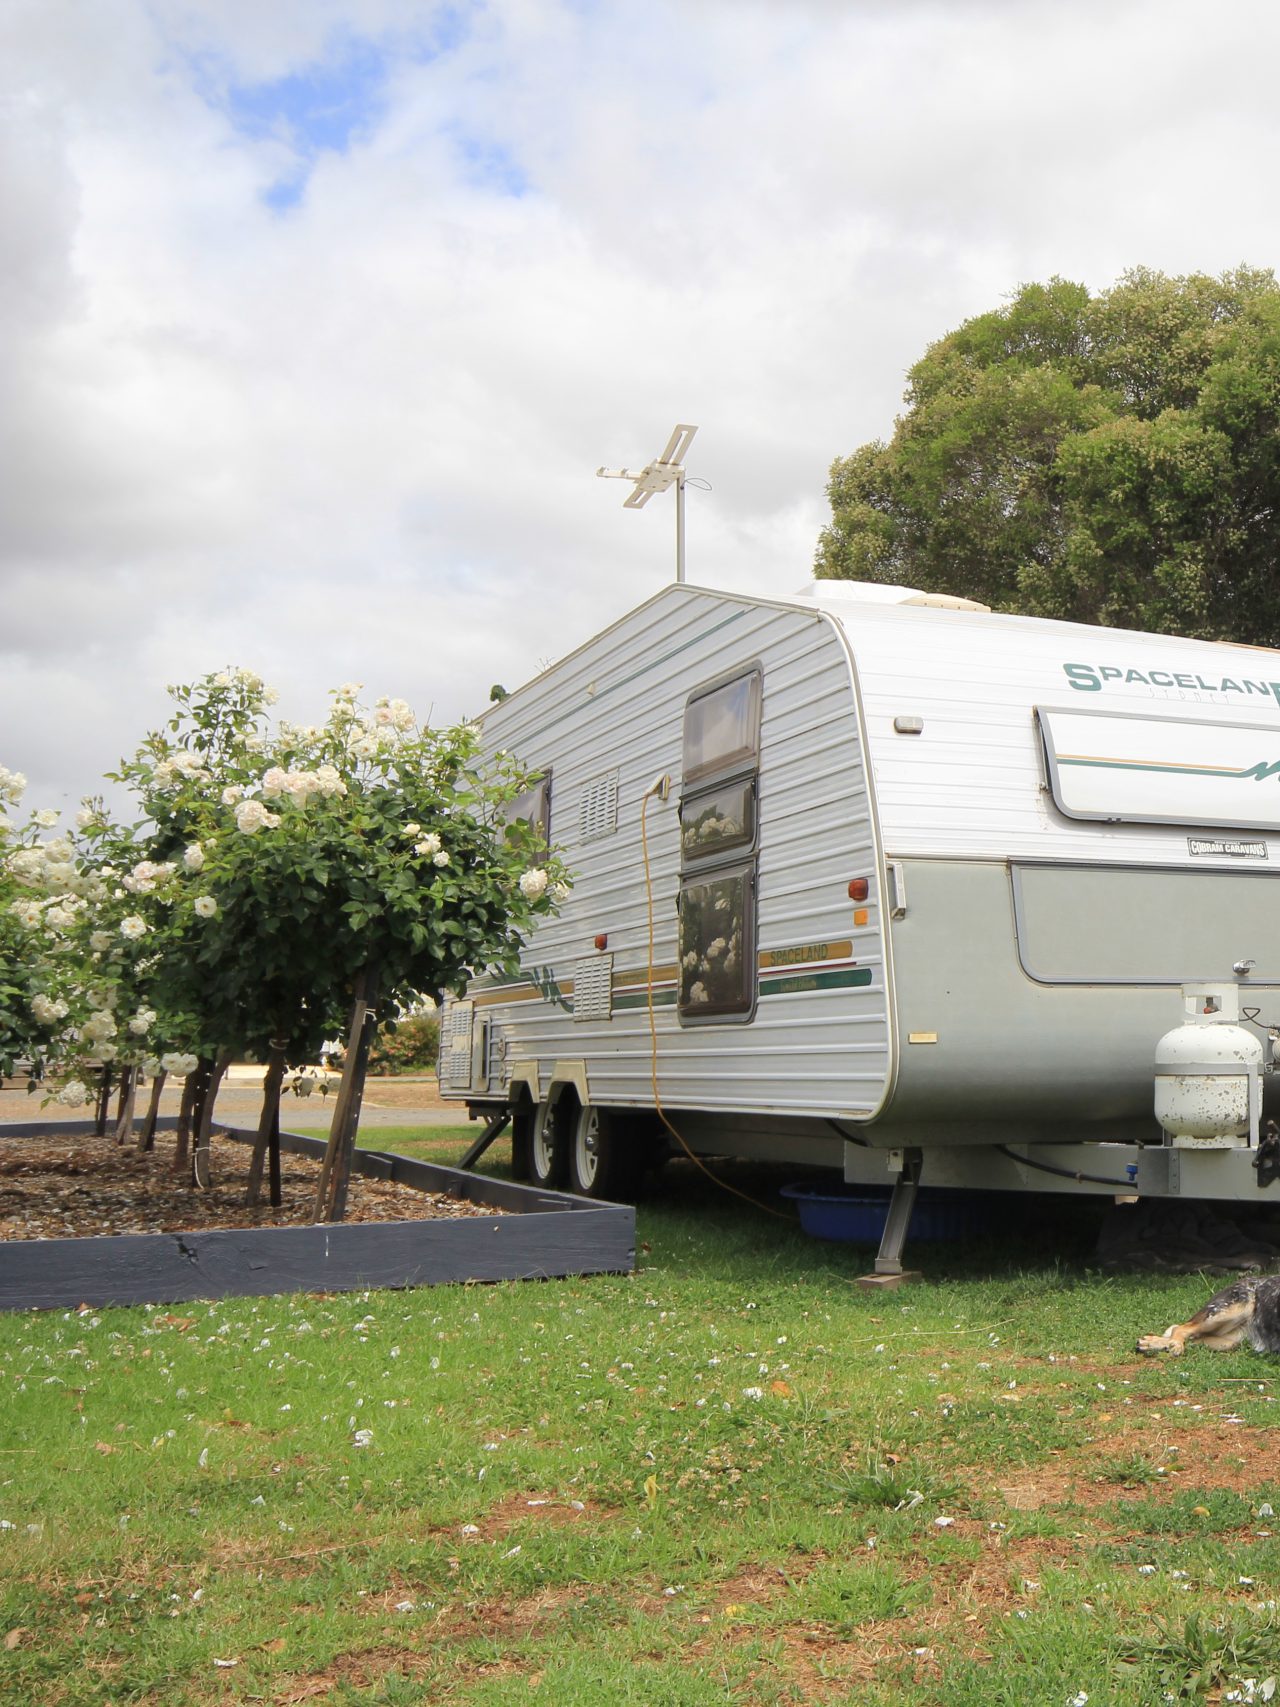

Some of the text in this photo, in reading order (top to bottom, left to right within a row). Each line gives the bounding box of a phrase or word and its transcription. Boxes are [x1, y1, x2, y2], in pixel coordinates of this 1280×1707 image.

[1191, 840, 1265, 857] COBRAM CARAVANS
[770, 943, 828, 967] SPACELAND
